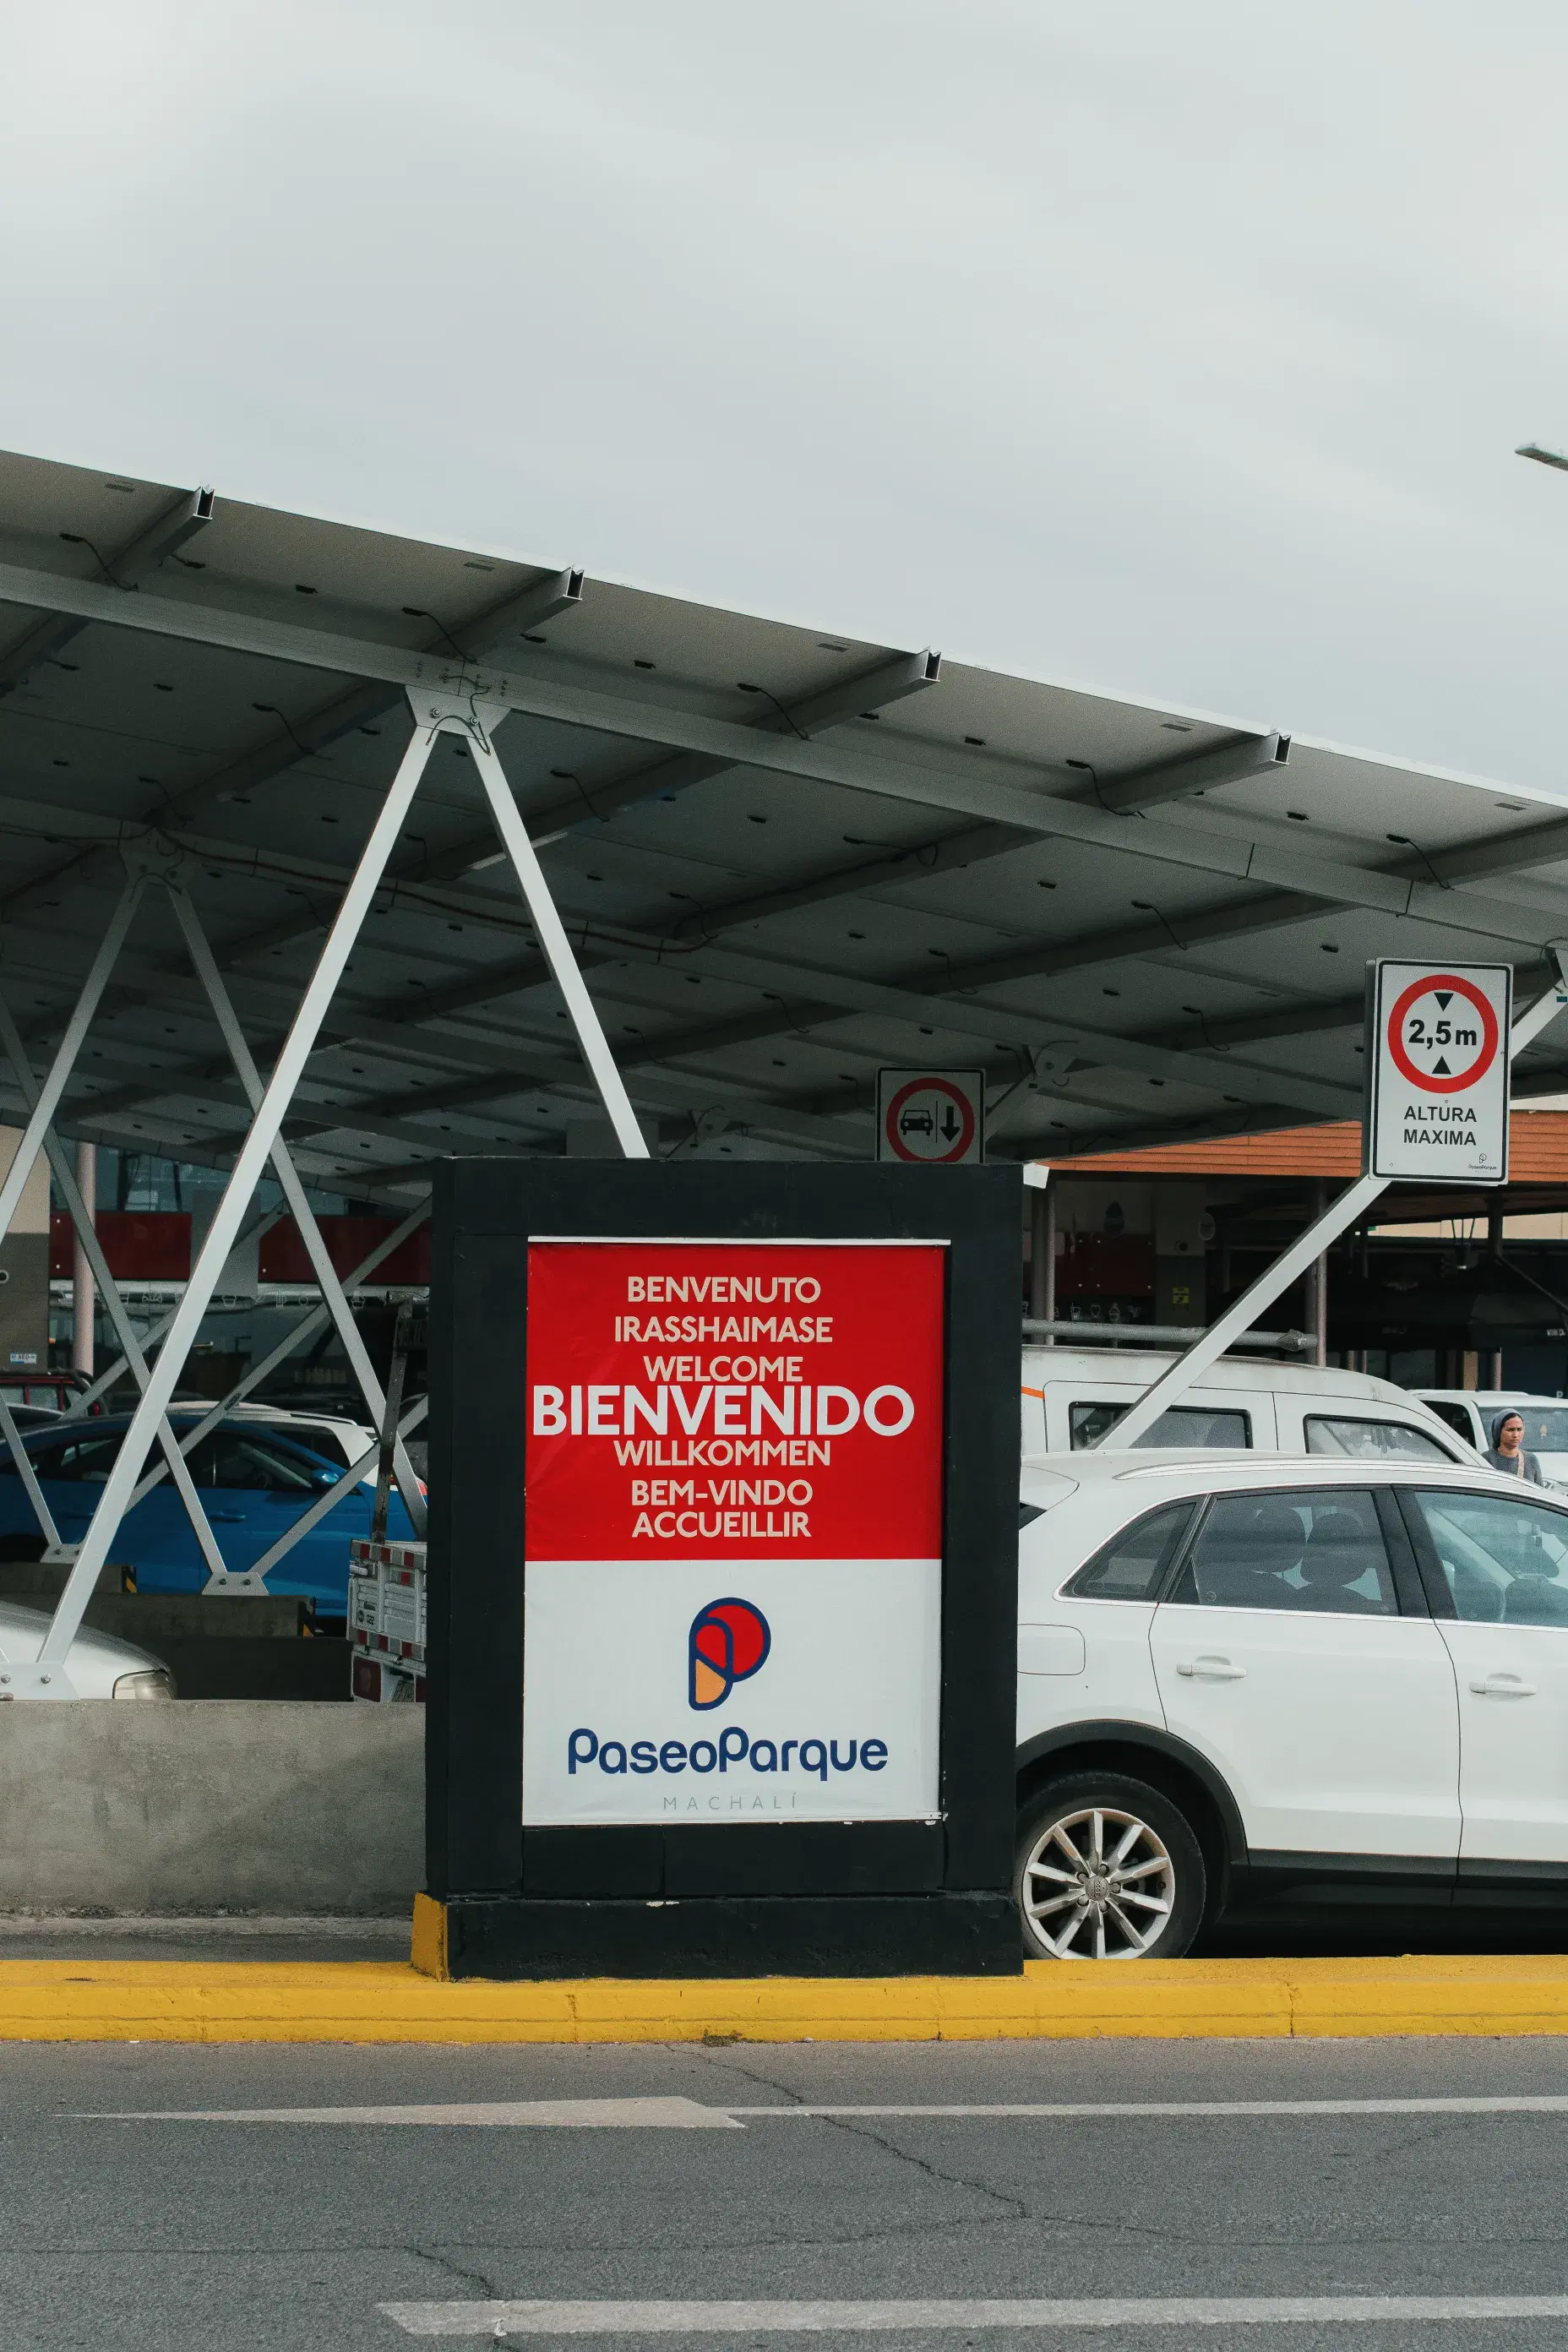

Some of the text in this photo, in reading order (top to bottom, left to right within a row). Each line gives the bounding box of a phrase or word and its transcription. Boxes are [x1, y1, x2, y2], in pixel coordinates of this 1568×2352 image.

[1403, 1105, 1477, 1123] ALTURA
[1403, 1129, 1477, 1146] MAXIMA
[628, 1276, 821, 1304] BENVENUTO
[615, 1315, 834, 1342] IRASSHAIMASE
[643, 1355, 803, 1382] WELCOME
[532, 1384, 915, 1437] BIENVENIDO
[613, 1440, 830, 1466] WILLKOMMEN
[632, 1479, 814, 1505] BEM-VINDO
[632, 1511, 812, 1538] ACCUEILLIR
[568, 1726, 889, 1782] PaseoParque
[663, 1792, 797, 1810] MACHALÍ
